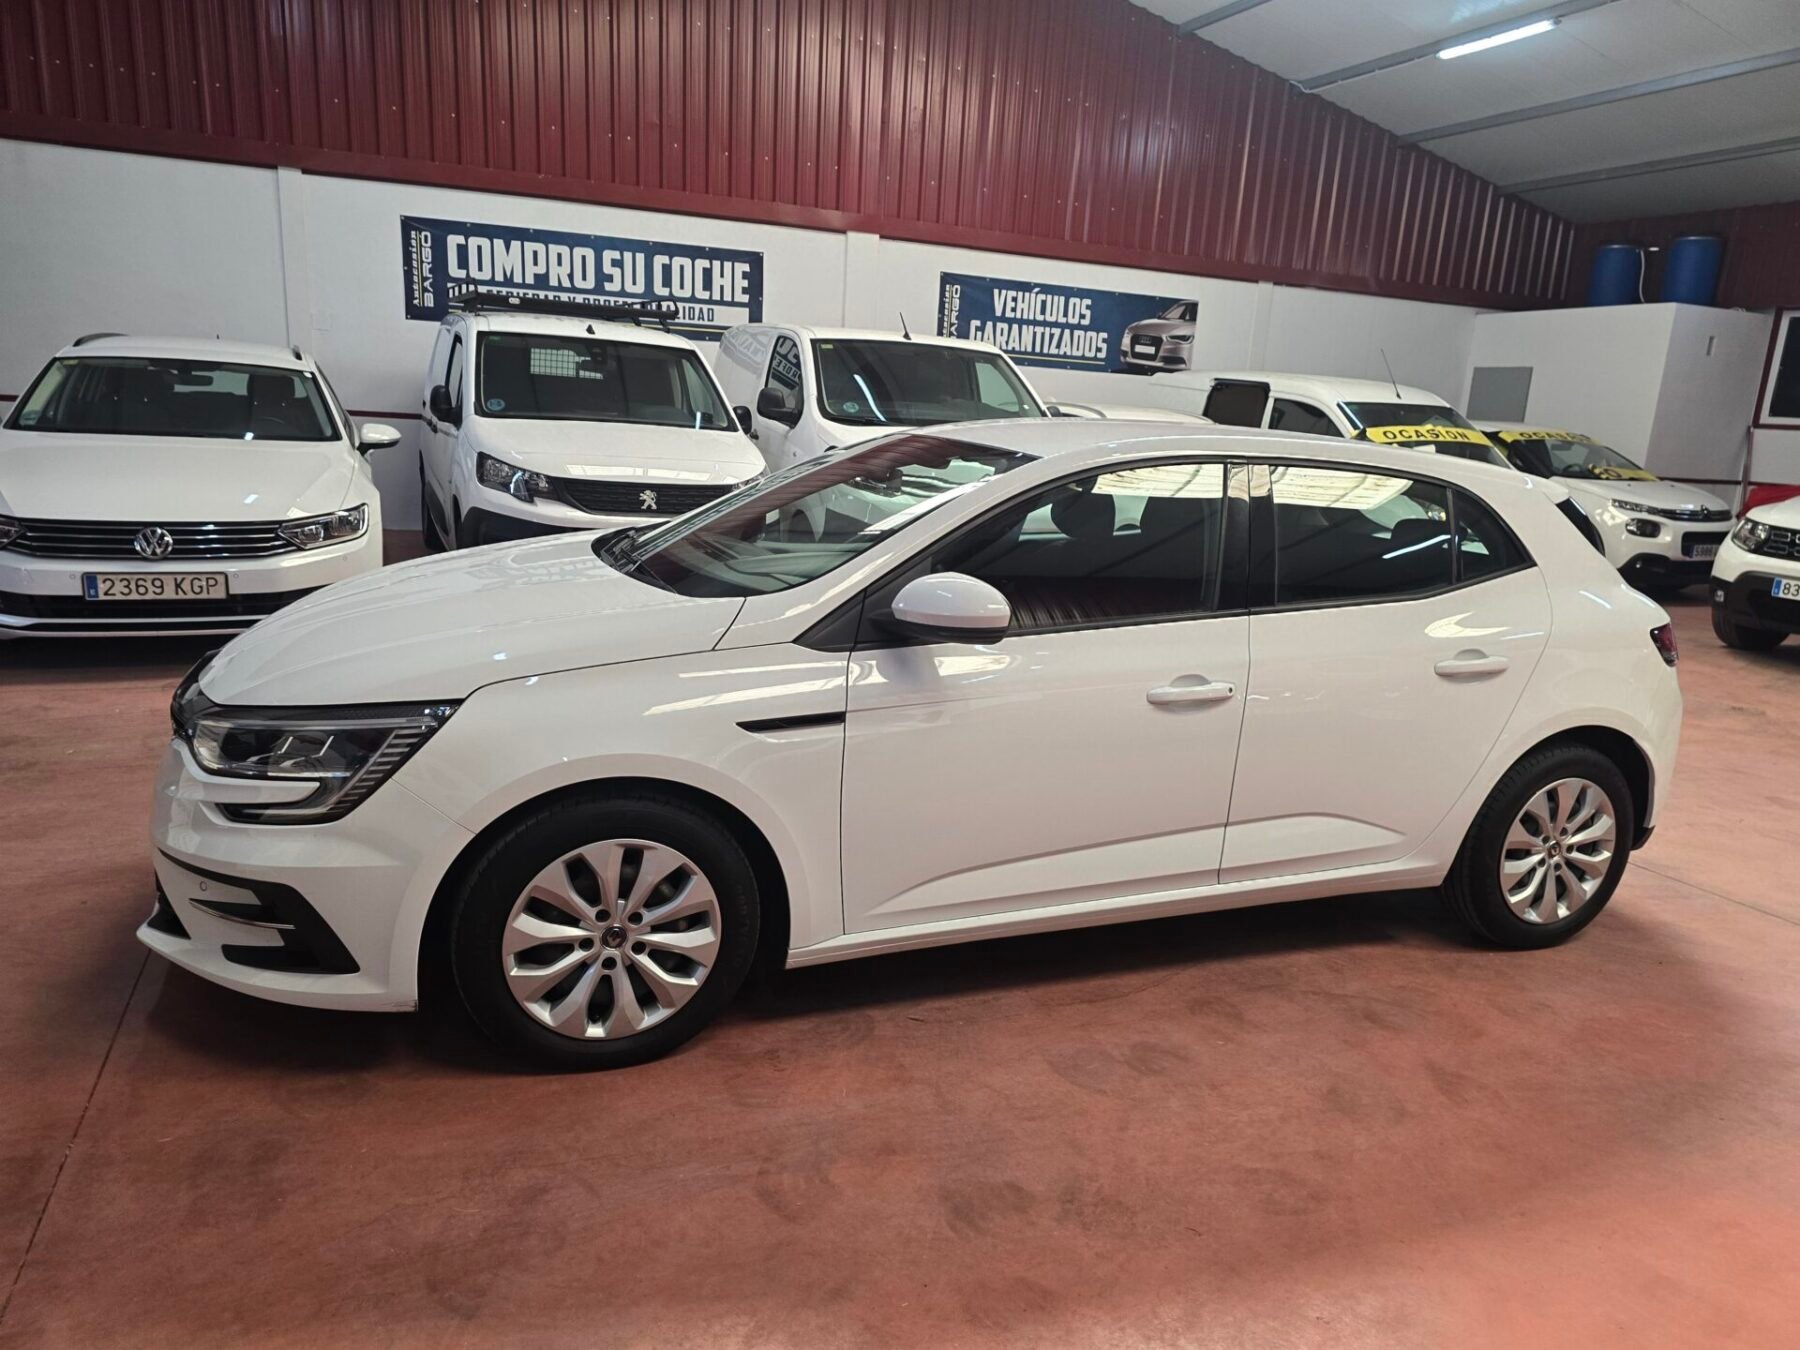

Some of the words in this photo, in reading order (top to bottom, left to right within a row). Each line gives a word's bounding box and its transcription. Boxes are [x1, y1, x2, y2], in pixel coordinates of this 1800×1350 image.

[447, 234, 596, 289] COMPRO
[602, 249, 645, 294] SU
[653, 254, 750, 303] COCHE
[993, 287, 1092, 325] VEHÍCULOS
[970, 319, 1108, 359] GARANTIZADOS
[1382, 428, 1471, 441] OCASION
[102, 577, 165, 596] 2369
[173, 576, 218, 595] KGP
